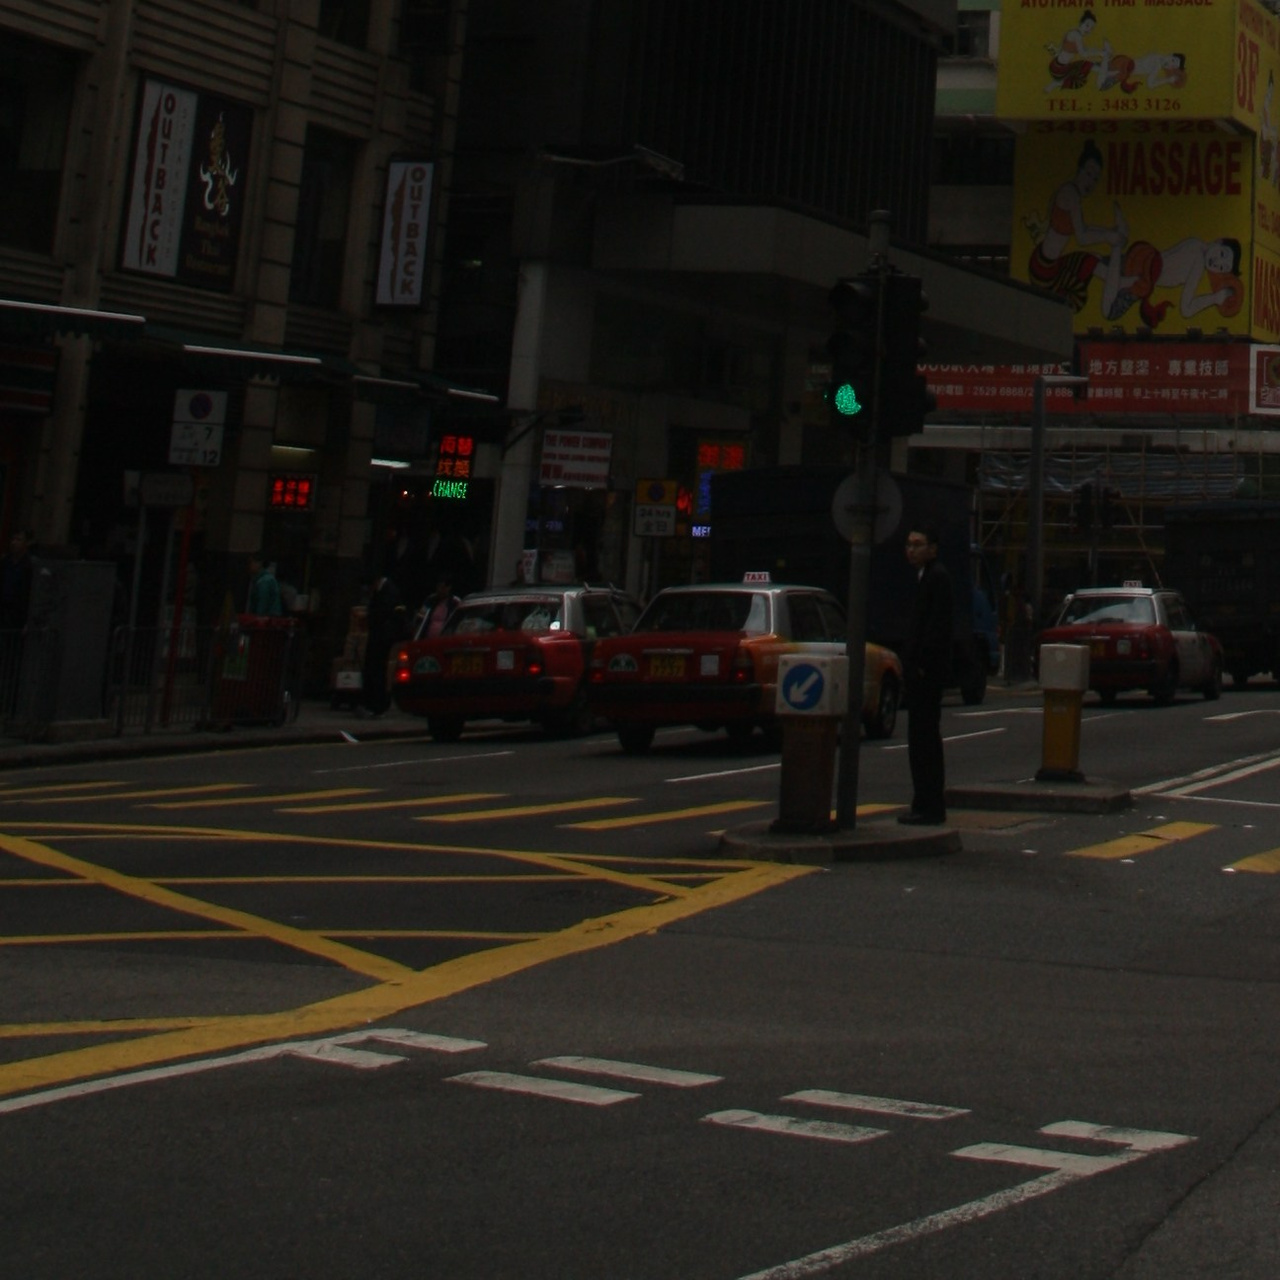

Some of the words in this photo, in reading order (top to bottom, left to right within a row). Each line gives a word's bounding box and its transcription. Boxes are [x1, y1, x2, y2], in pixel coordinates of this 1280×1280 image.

[1101, 98, 1139, 112] 3483
[1145, 98, 1181, 112] 3126
[1106, 140, 1242, 196] MASSAGE
[147, 92, 176, 267] OUTBACK
[400, 166, 427, 296] OUTBACK
[205, 426, 213, 440] 7
[203, 450, 218, 464] 12
[433, 480, 468, 498] CHANGE
[746, 573, 767, 581] TAXI
